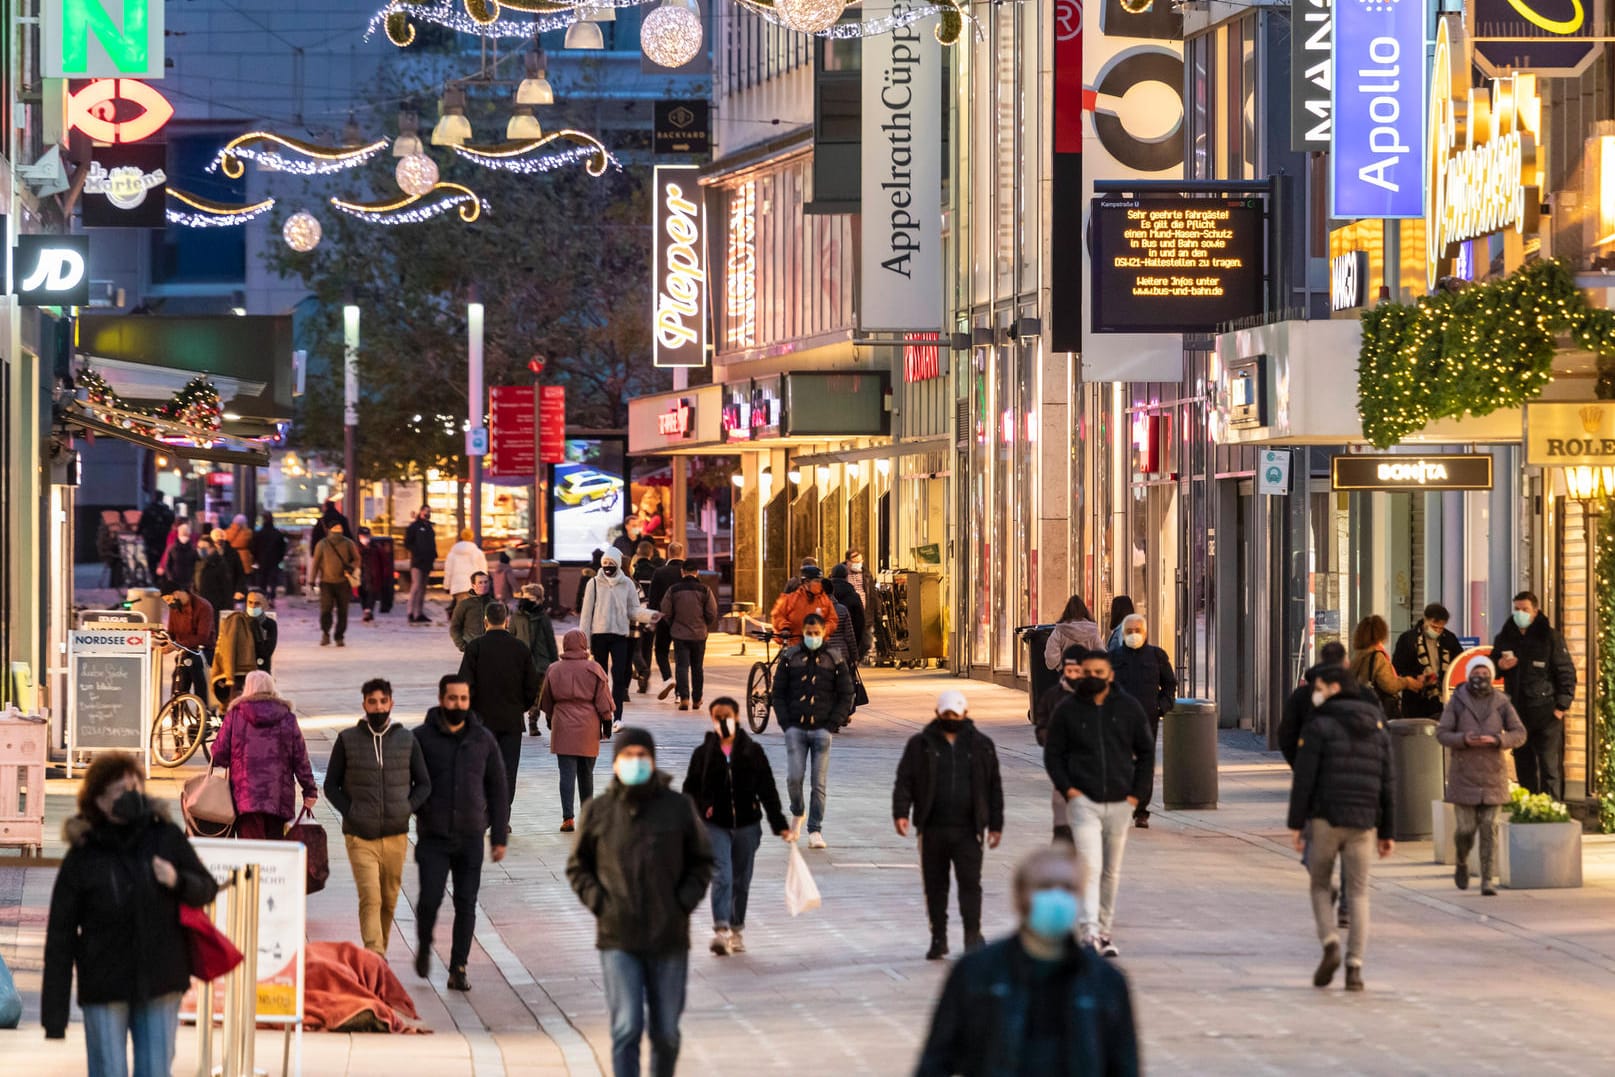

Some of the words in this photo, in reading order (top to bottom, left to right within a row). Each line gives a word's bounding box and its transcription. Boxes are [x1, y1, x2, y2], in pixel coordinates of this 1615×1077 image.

[1304, 0, 1331, 141] MAN
[1358, 36, 1410, 193] Apollo
[656, 131, 705, 139] BACKYARD
[881, 0, 921, 279] AppelrathCüppe
[1127, 210, 1148, 219] Sehr
[1149, 210, 1183, 220] geehrte
[1184, 210, 1229, 220] Fahrgäste!
[1140, 220, 1152, 229] Es
[1153, 220, 1169, 230] gilt
[1170, 220, 1185, 229] die
[1186, 220, 1216, 230] Pflicht
[1123, 229, 1148, 239] einen
[1149, 229, 1233, 239] Mund-Nasen-Schutz
[1130, 239, 1140, 248] in
[1141, 239, 1158, 248] Bus
[1159, 239, 1176, 248] und
[1177, 239, 1199, 248] Bahn
[1200, 239, 1226, 248] sowie
[1148, 248, 1158, 257] in
[1159, 248, 1176, 257] und
[1177, 248, 1189, 257] an
[1191, 248, 1207, 257] den
[657, 182, 706, 349] Pieper
[1198, 258, 1210, 267] zu
[1211, 258, 1242, 269] tragen.
[22, 248, 84, 292] JD
[1136, 276, 1169, 286] Weitere
[1170, 276, 1194, 286] Infos
[1195, 276, 1220, 286] unter
[1132, 286, 1224, 296] www.bus-und-bahn.de
[75, 636, 126, 645] NORDSEE
